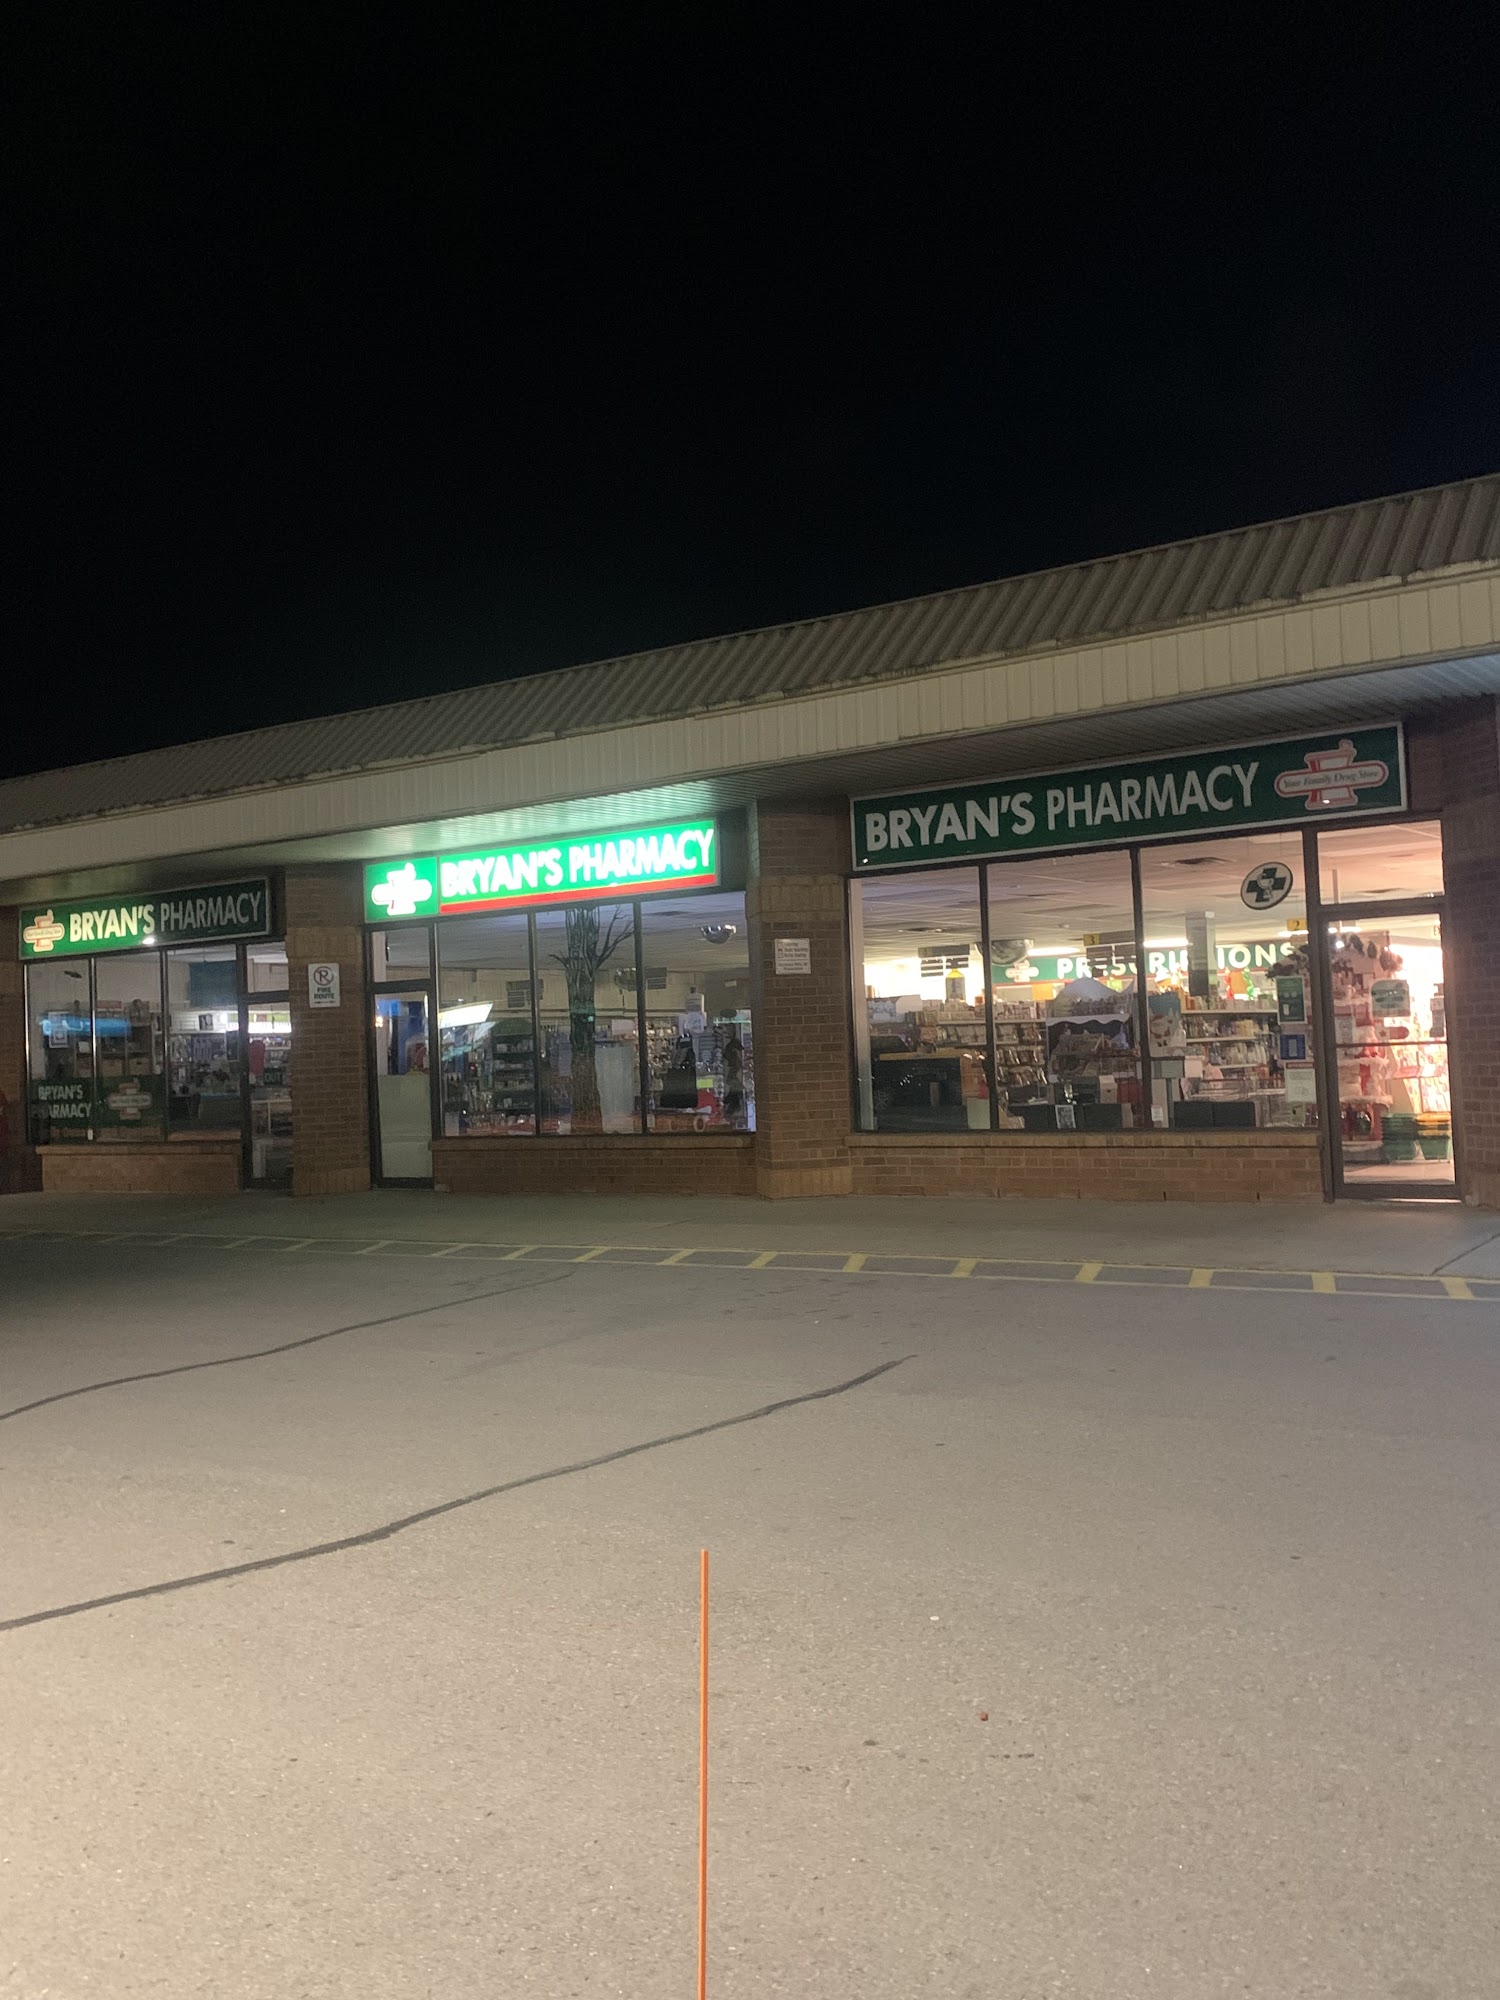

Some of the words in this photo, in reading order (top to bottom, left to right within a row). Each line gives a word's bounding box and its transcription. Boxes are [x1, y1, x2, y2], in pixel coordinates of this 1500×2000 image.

[866, 792, 1036, 852] BRYAN'S
[1047, 762, 1259, 831] PHARMACY
[440, 848, 563, 898] BRYAN'S
[568, 829, 714, 883] PHARMACY
[70, 904, 155, 942] BRYAN'S
[160, 891, 261, 932] PHARMACY
[1057, 942, 1296, 979] PRSRIIONS
[34, 1102, 91, 1119] RMACY
